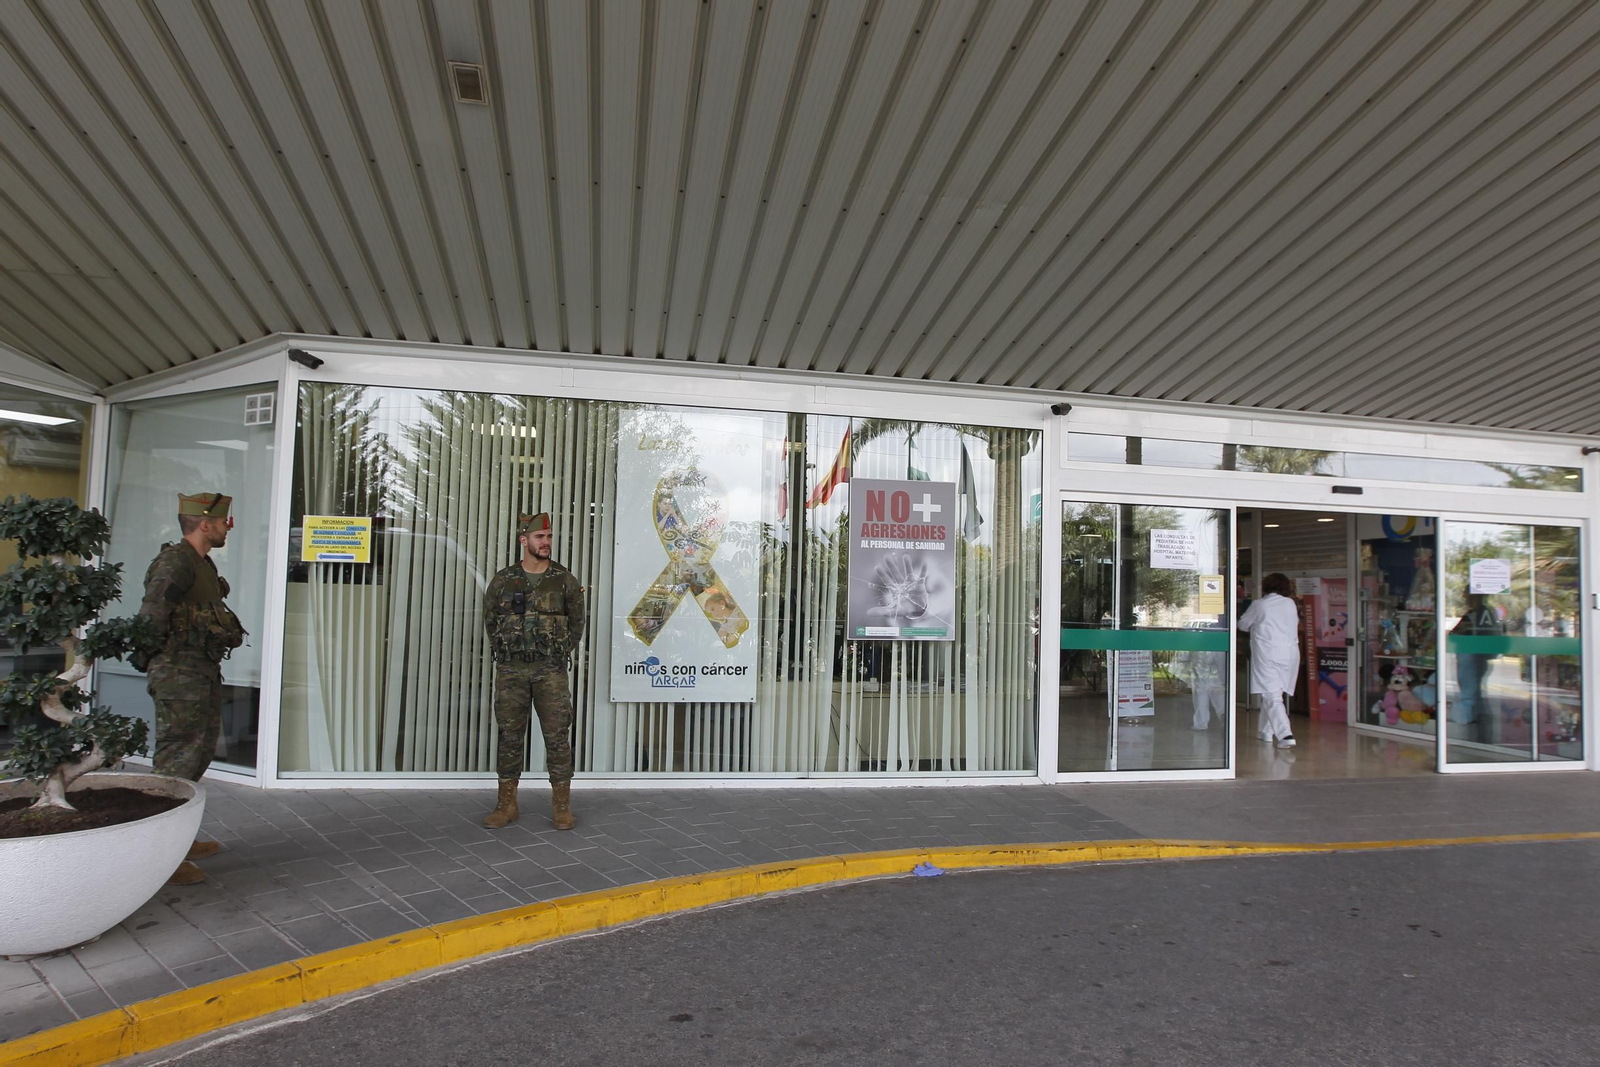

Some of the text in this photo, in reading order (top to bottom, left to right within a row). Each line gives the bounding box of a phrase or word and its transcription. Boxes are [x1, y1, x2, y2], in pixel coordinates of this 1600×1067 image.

[861, 523, 945, 540] AGRESIONES
[861, 540, 945, 550] AL PERSONAL DE SANIDAD
[672, 665, 696, 675] con
[701, 662, 748, 675] cáncer
